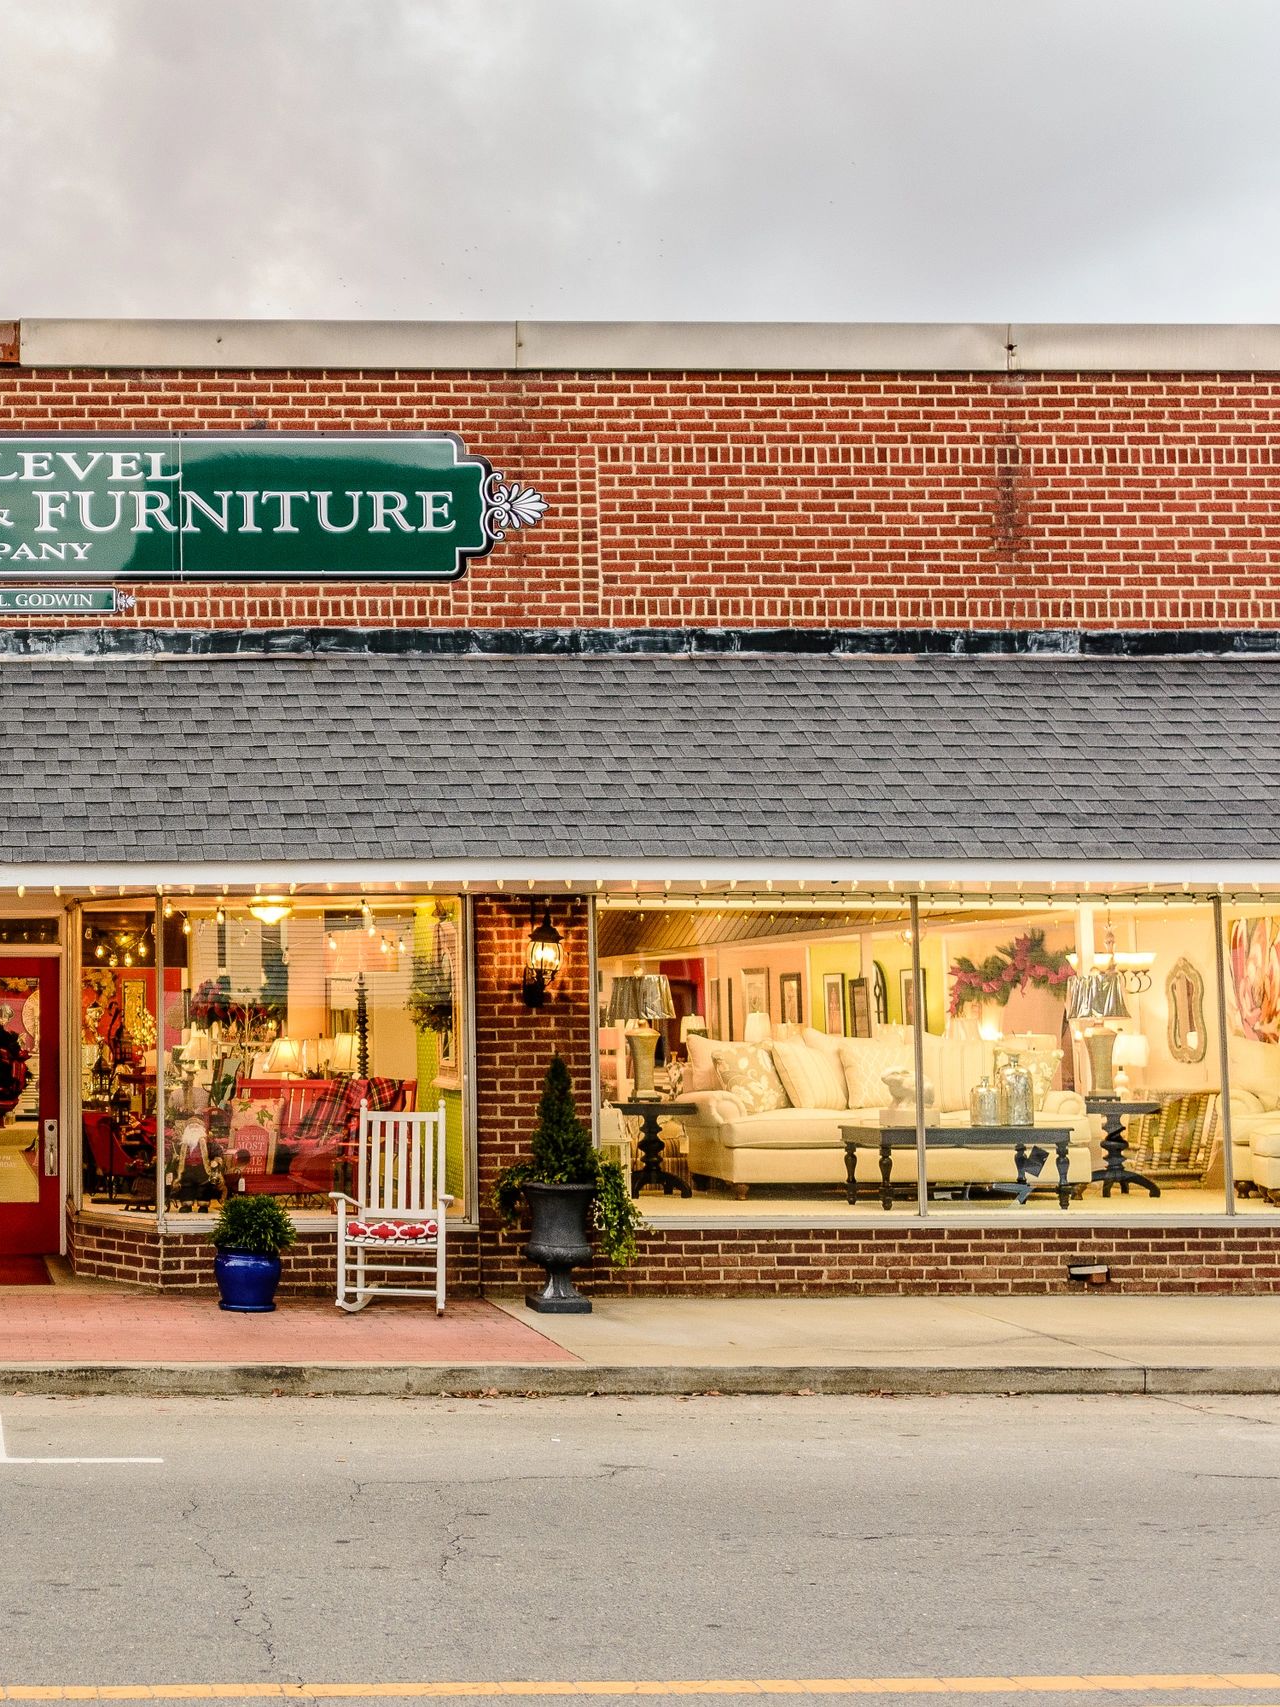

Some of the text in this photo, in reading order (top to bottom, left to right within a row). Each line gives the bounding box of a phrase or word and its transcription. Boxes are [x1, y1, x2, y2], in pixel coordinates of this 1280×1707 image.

[32, 489, 457, 534] FURNITURE
[15, 593, 93, 607] GODWIN
[237, 1141, 265, 1151] MOST
